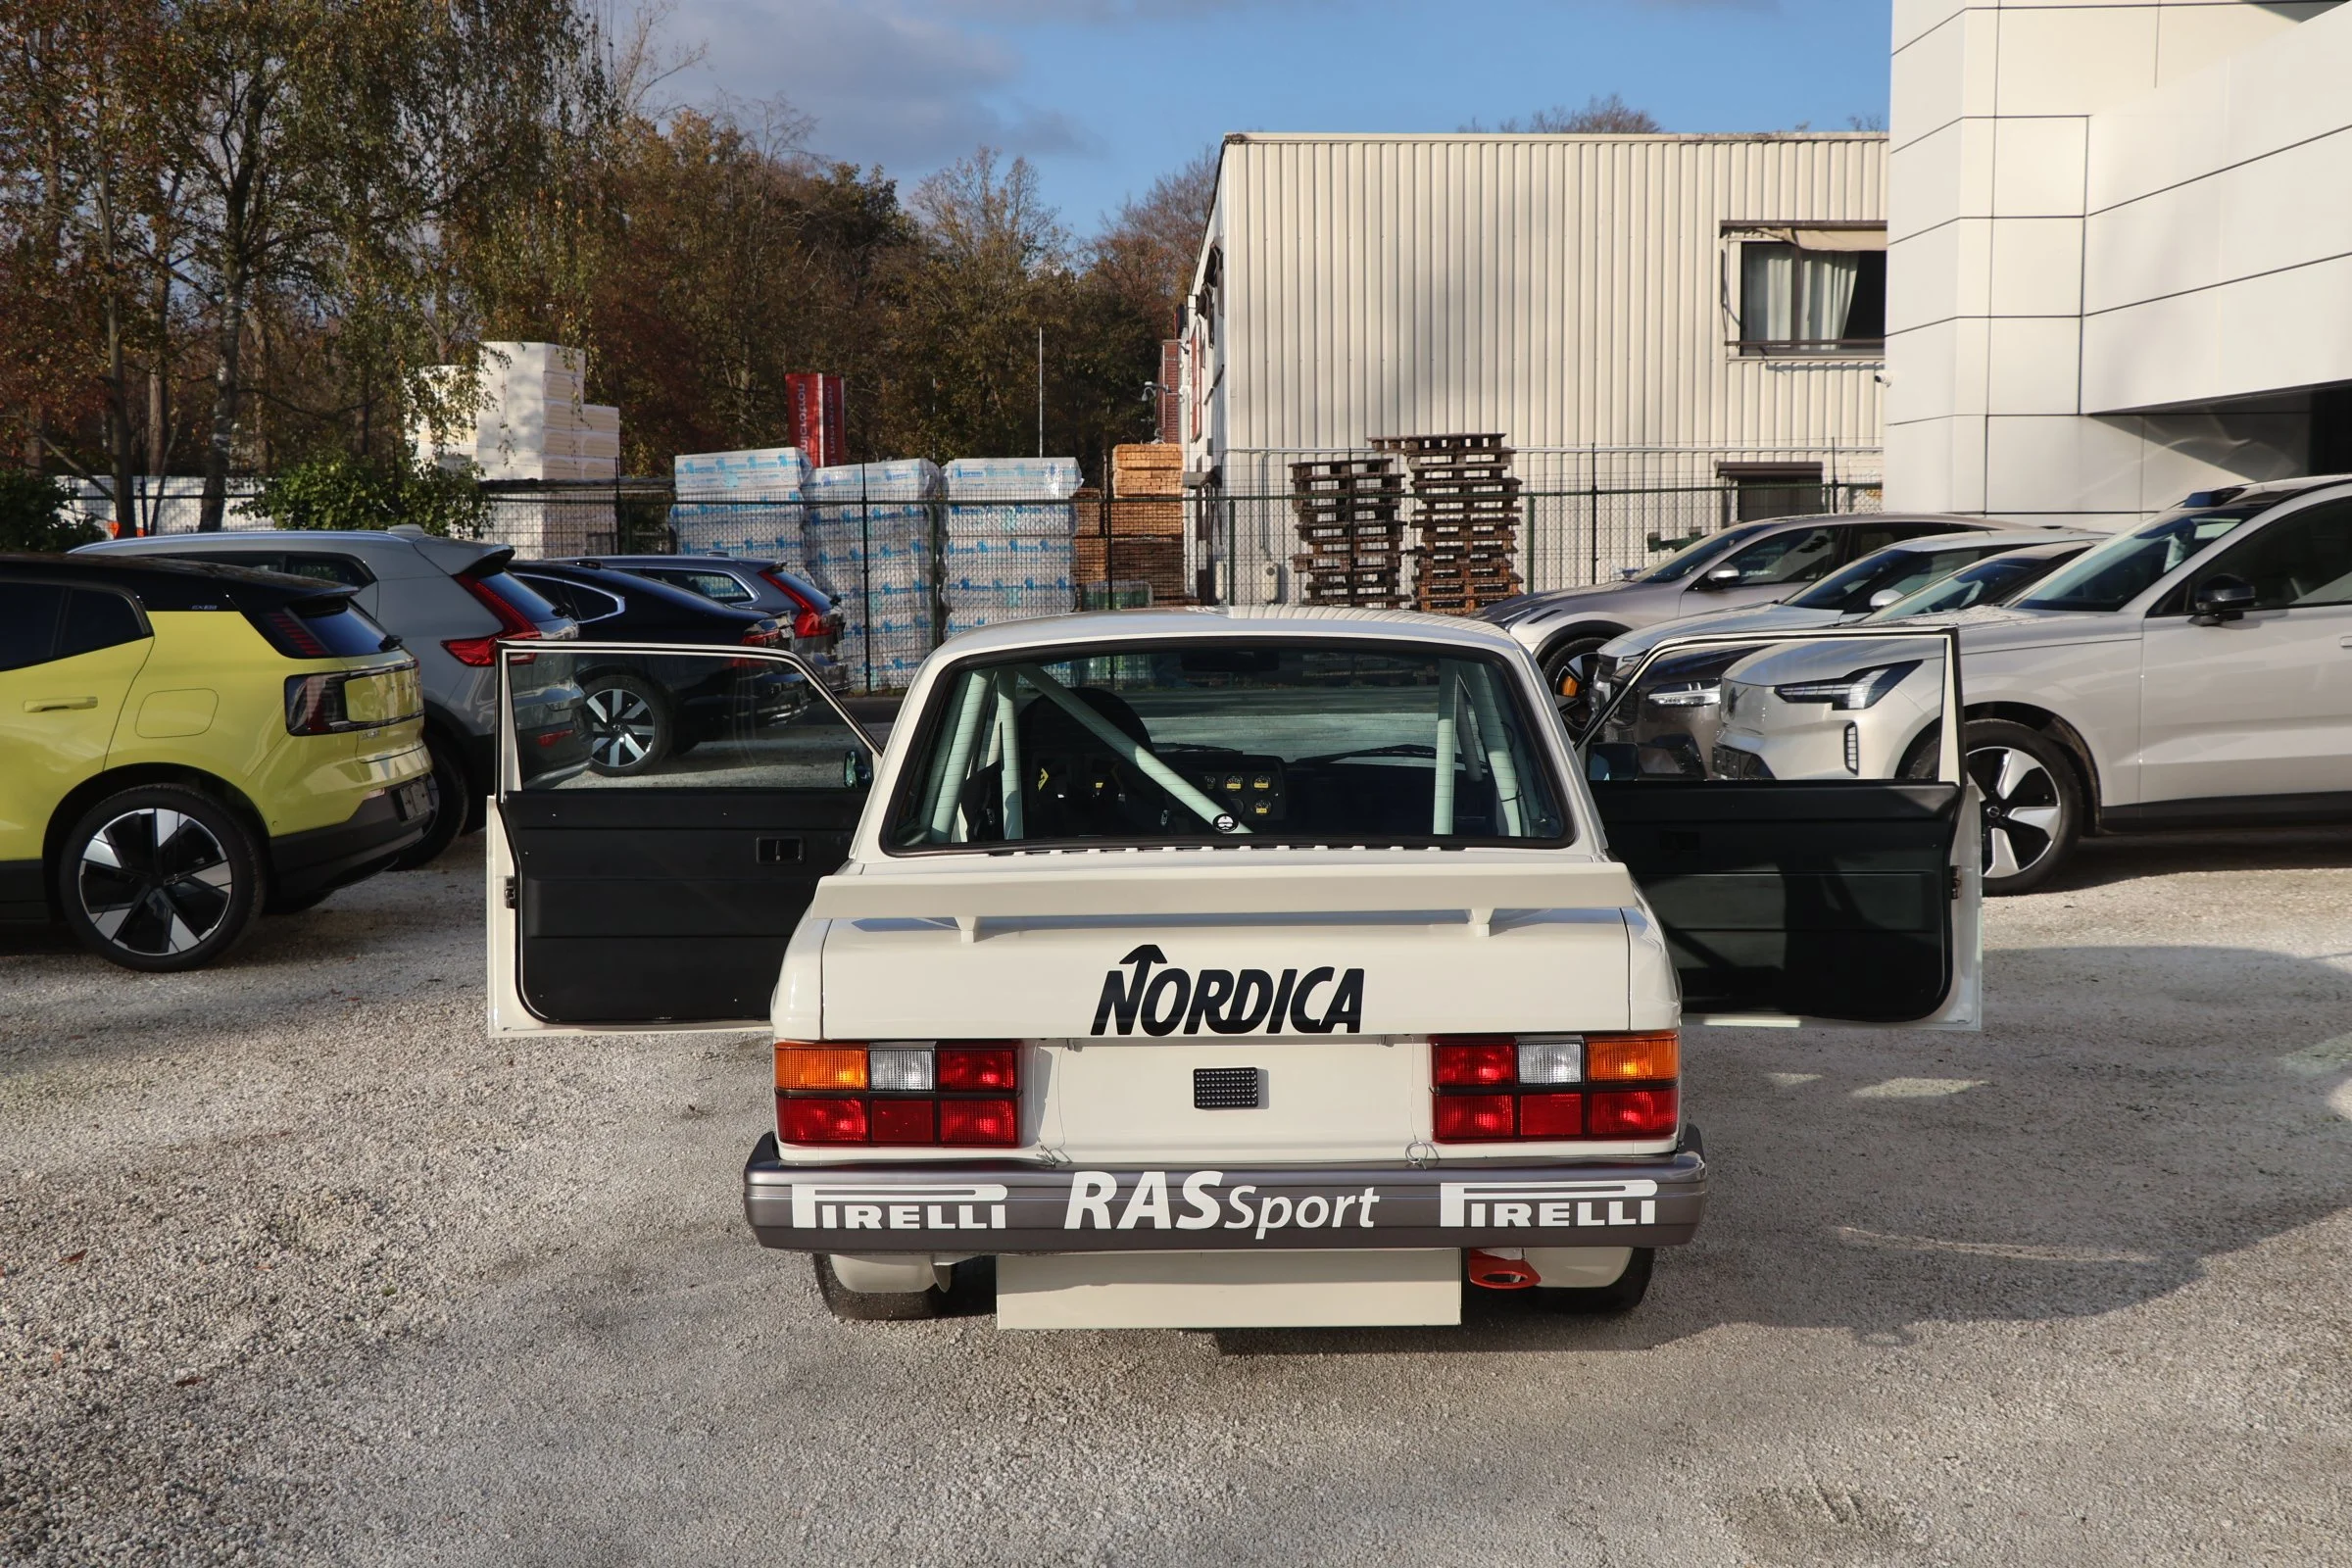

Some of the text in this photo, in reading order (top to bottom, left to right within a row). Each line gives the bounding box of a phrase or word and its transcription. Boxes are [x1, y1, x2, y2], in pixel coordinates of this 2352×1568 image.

[1090, 945, 1365, 1037] NORDICA
[792, 1184, 1007, 1229] PIRELLI
[1064, 1170, 1380, 1240] RAS Sport
[1440, 1179, 1658, 1227] PIRELLI
